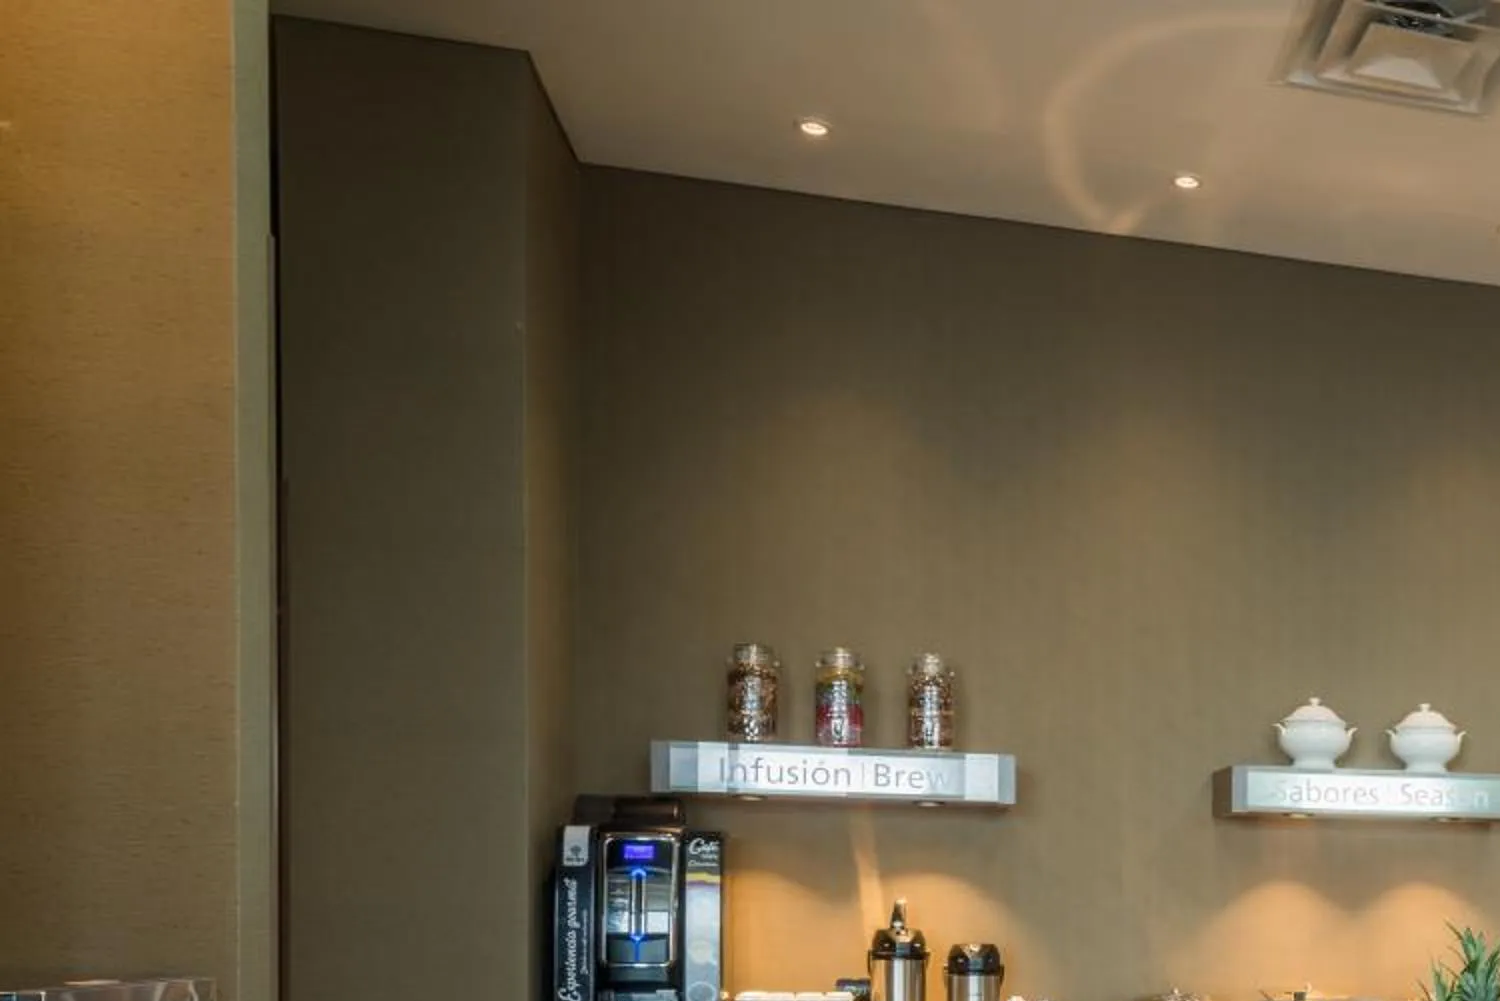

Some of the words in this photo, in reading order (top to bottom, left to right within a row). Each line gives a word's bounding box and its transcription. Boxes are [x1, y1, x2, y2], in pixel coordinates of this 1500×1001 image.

[718, 755, 852, 787] Infusión
[873, 762, 951, 789] Brew
[1273, 778, 1379, 805] Sabores
[1400, 783, 1490, 808] Seasn
